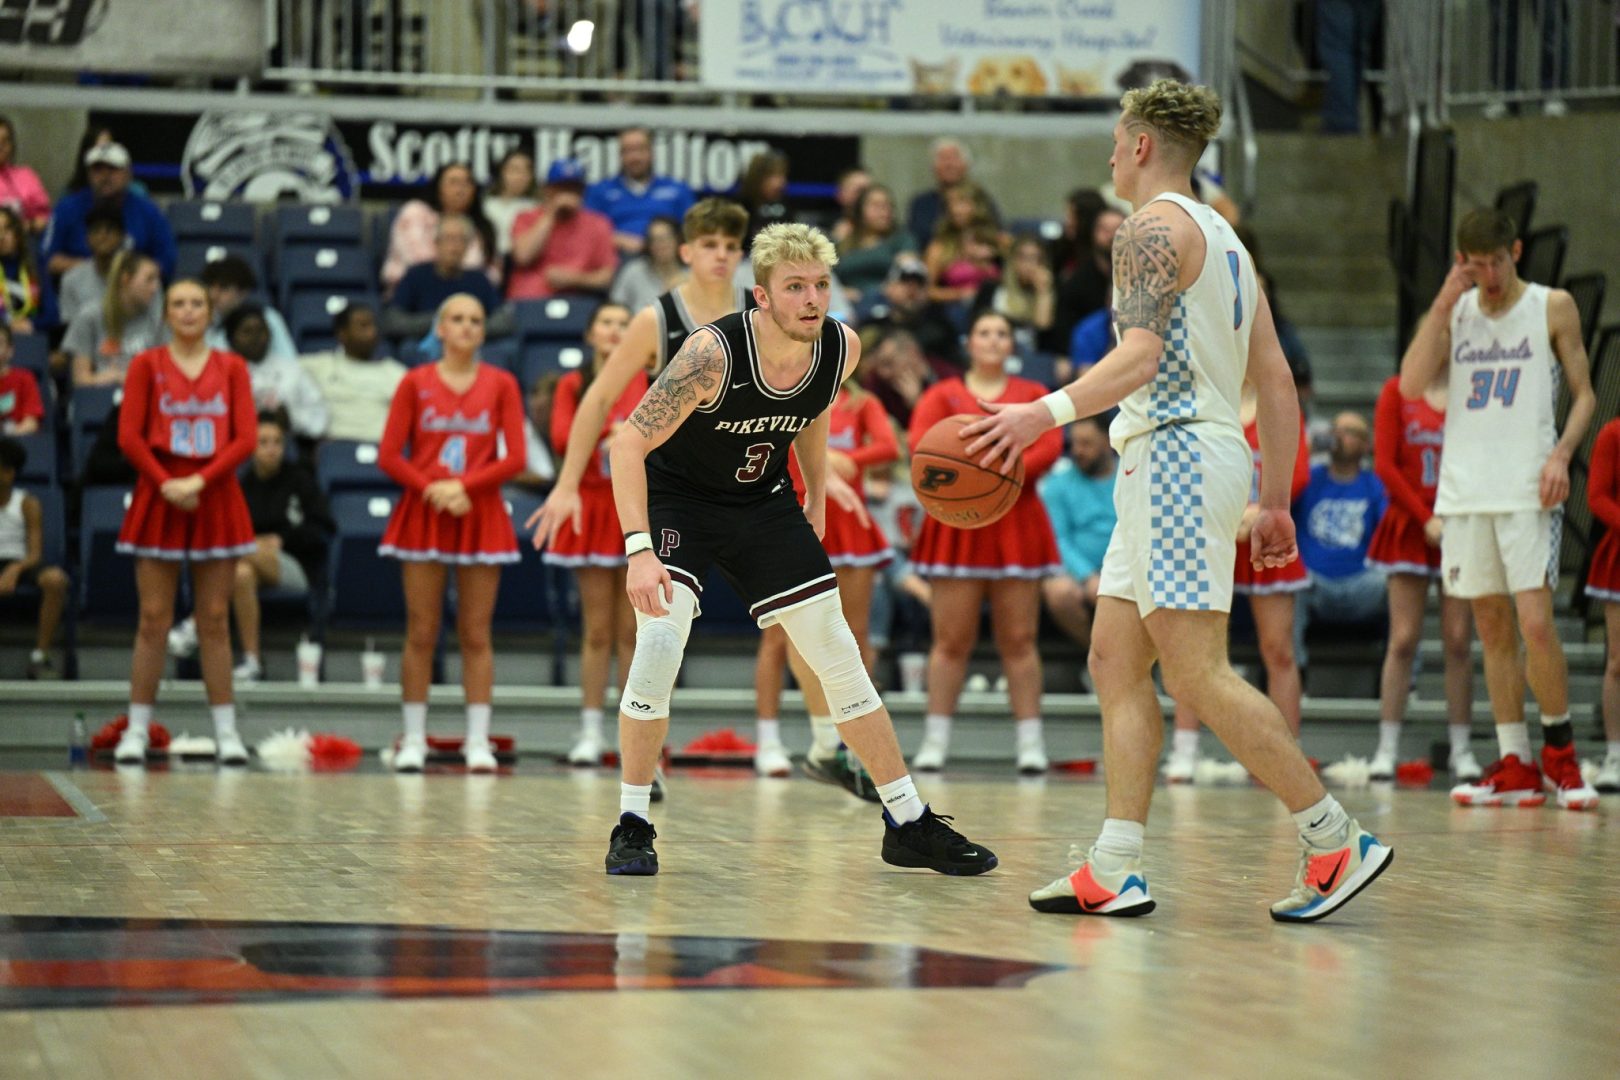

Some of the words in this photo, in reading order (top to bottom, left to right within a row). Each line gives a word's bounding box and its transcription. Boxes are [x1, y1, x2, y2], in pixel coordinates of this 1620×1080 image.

[1455, 336, 1534, 364] Cardinals
[1466, 367, 1521, 410] 34
[170, 418, 215, 457] 20
[714, 415, 816, 434] PIKEVILL
[438, 434, 467, 476] 4
[735, 442, 775, 483] 3
[919, 465, 959, 492] P
[659, 528, 680, 557] P
